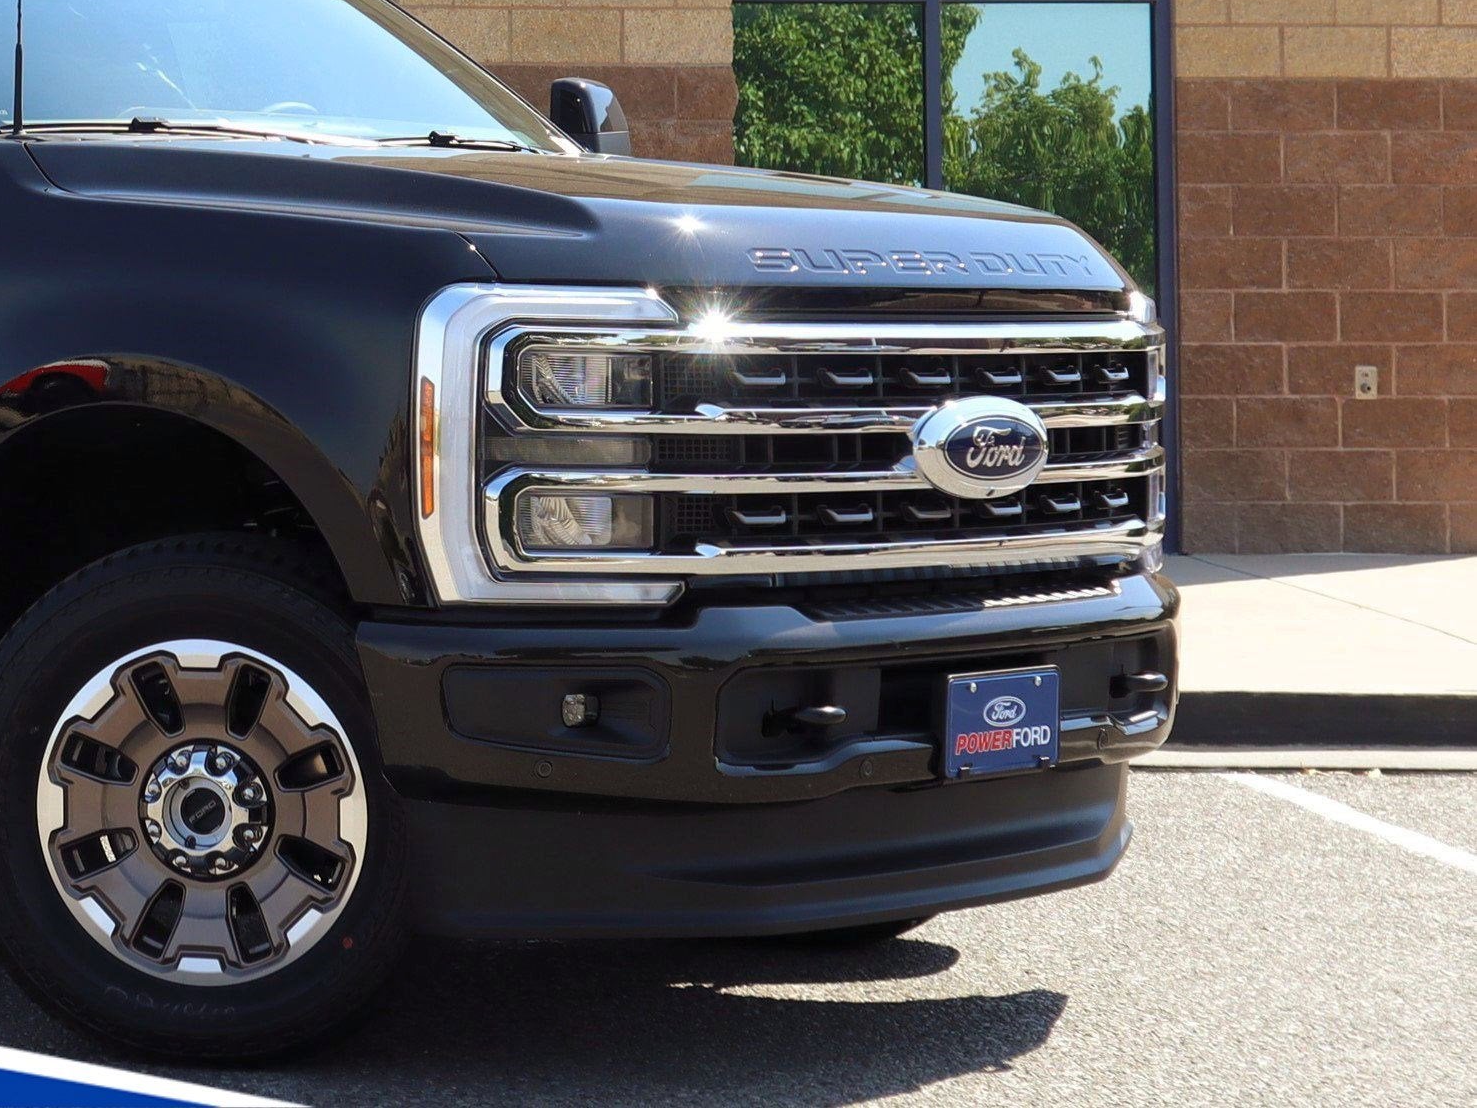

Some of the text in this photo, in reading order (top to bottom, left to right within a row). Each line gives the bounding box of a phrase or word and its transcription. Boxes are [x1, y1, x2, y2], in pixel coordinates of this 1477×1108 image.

[747, 247, 1095, 277] SUPER DUTY
[966, 426, 1026, 468] Ford
[991, 701, 1017, 720] Ford
[955, 725, 1051, 755] POWERFORD
